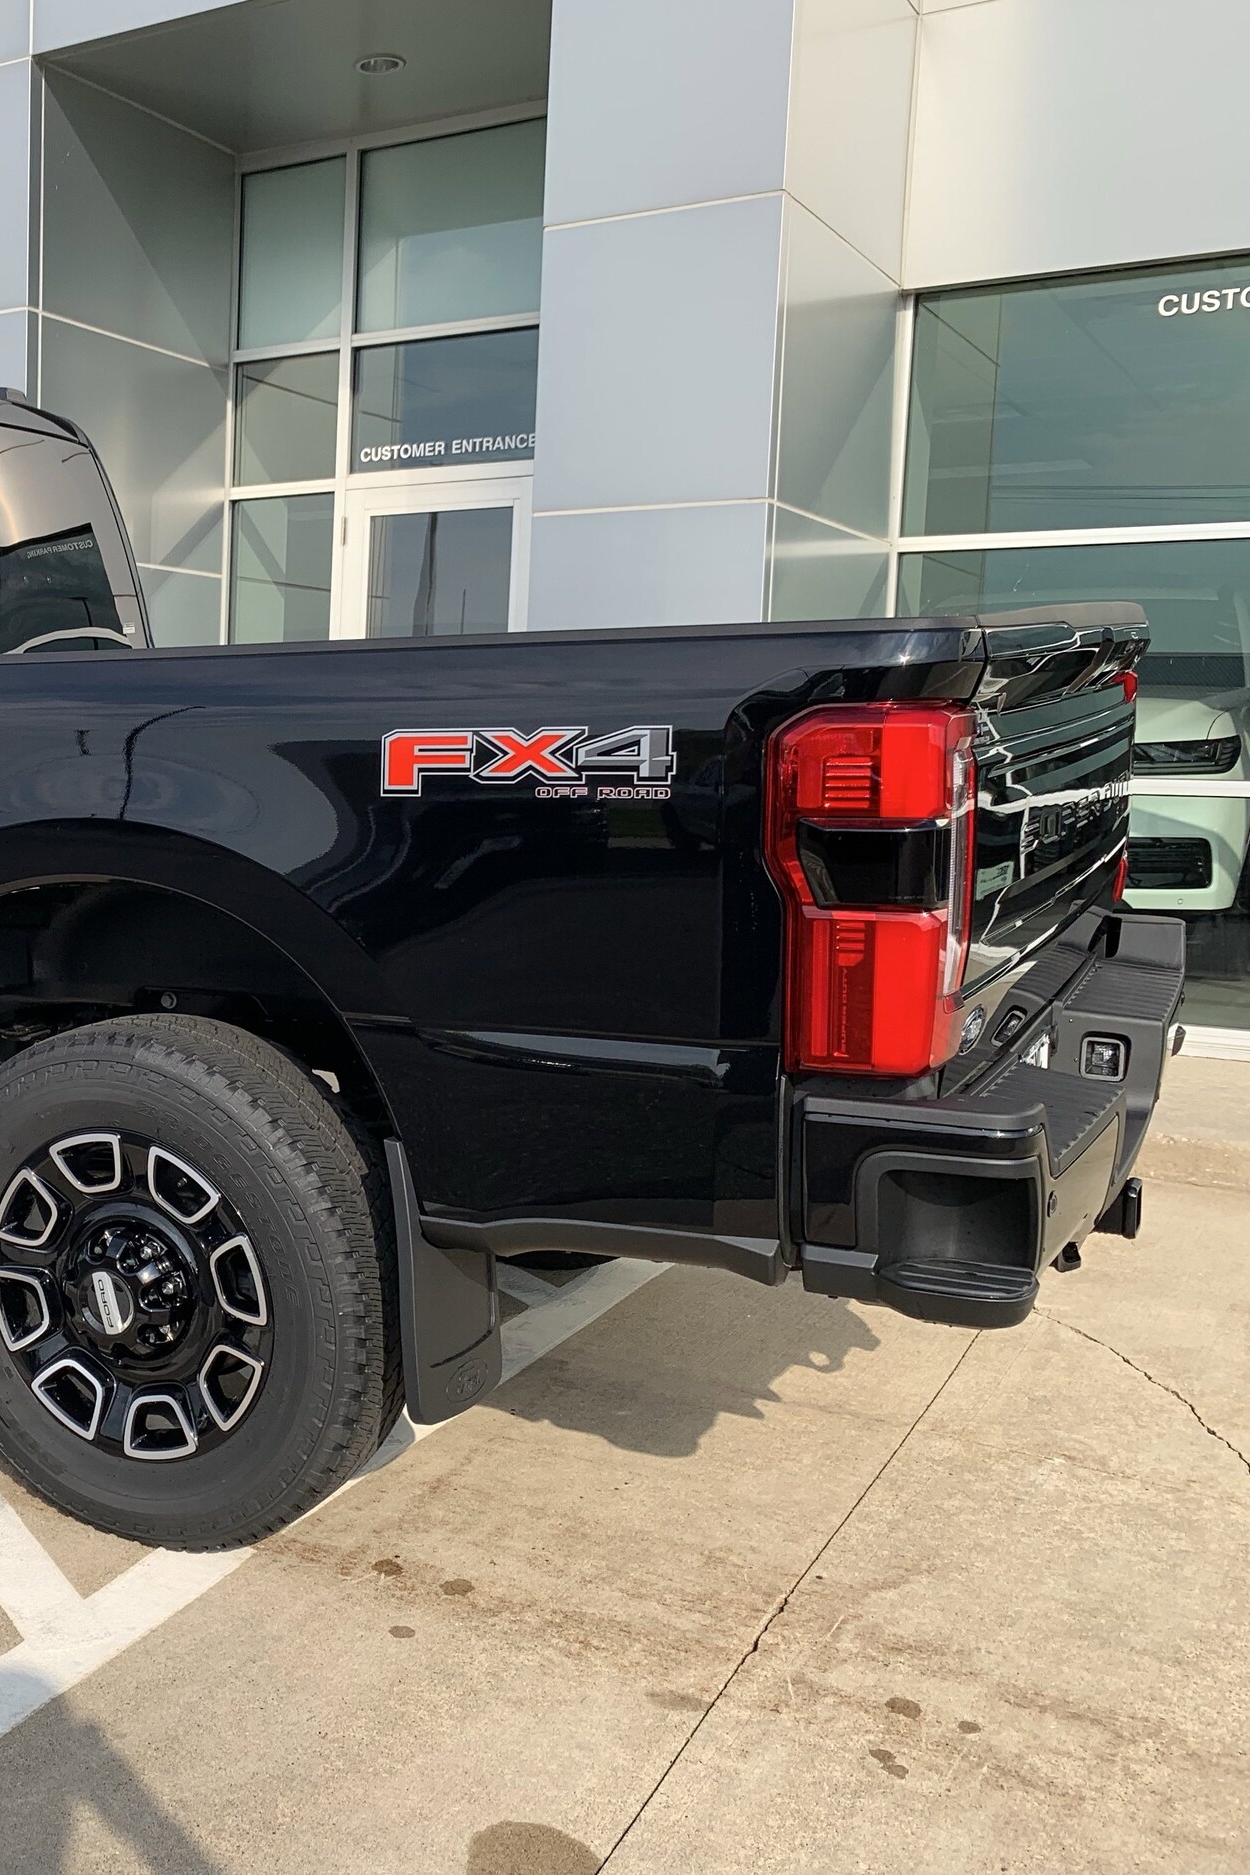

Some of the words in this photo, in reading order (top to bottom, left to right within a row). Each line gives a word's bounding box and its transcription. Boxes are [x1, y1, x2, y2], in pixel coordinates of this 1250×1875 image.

[360, 441, 445, 463] CUSTOMER
[451, 433, 536, 454] ENTRANCE
[380, 725, 677, 797] FX4
[534, 786, 589, 799] OFF
[597, 786, 672, 800] ROAD
[97, 1279, 114, 1328] FORD
